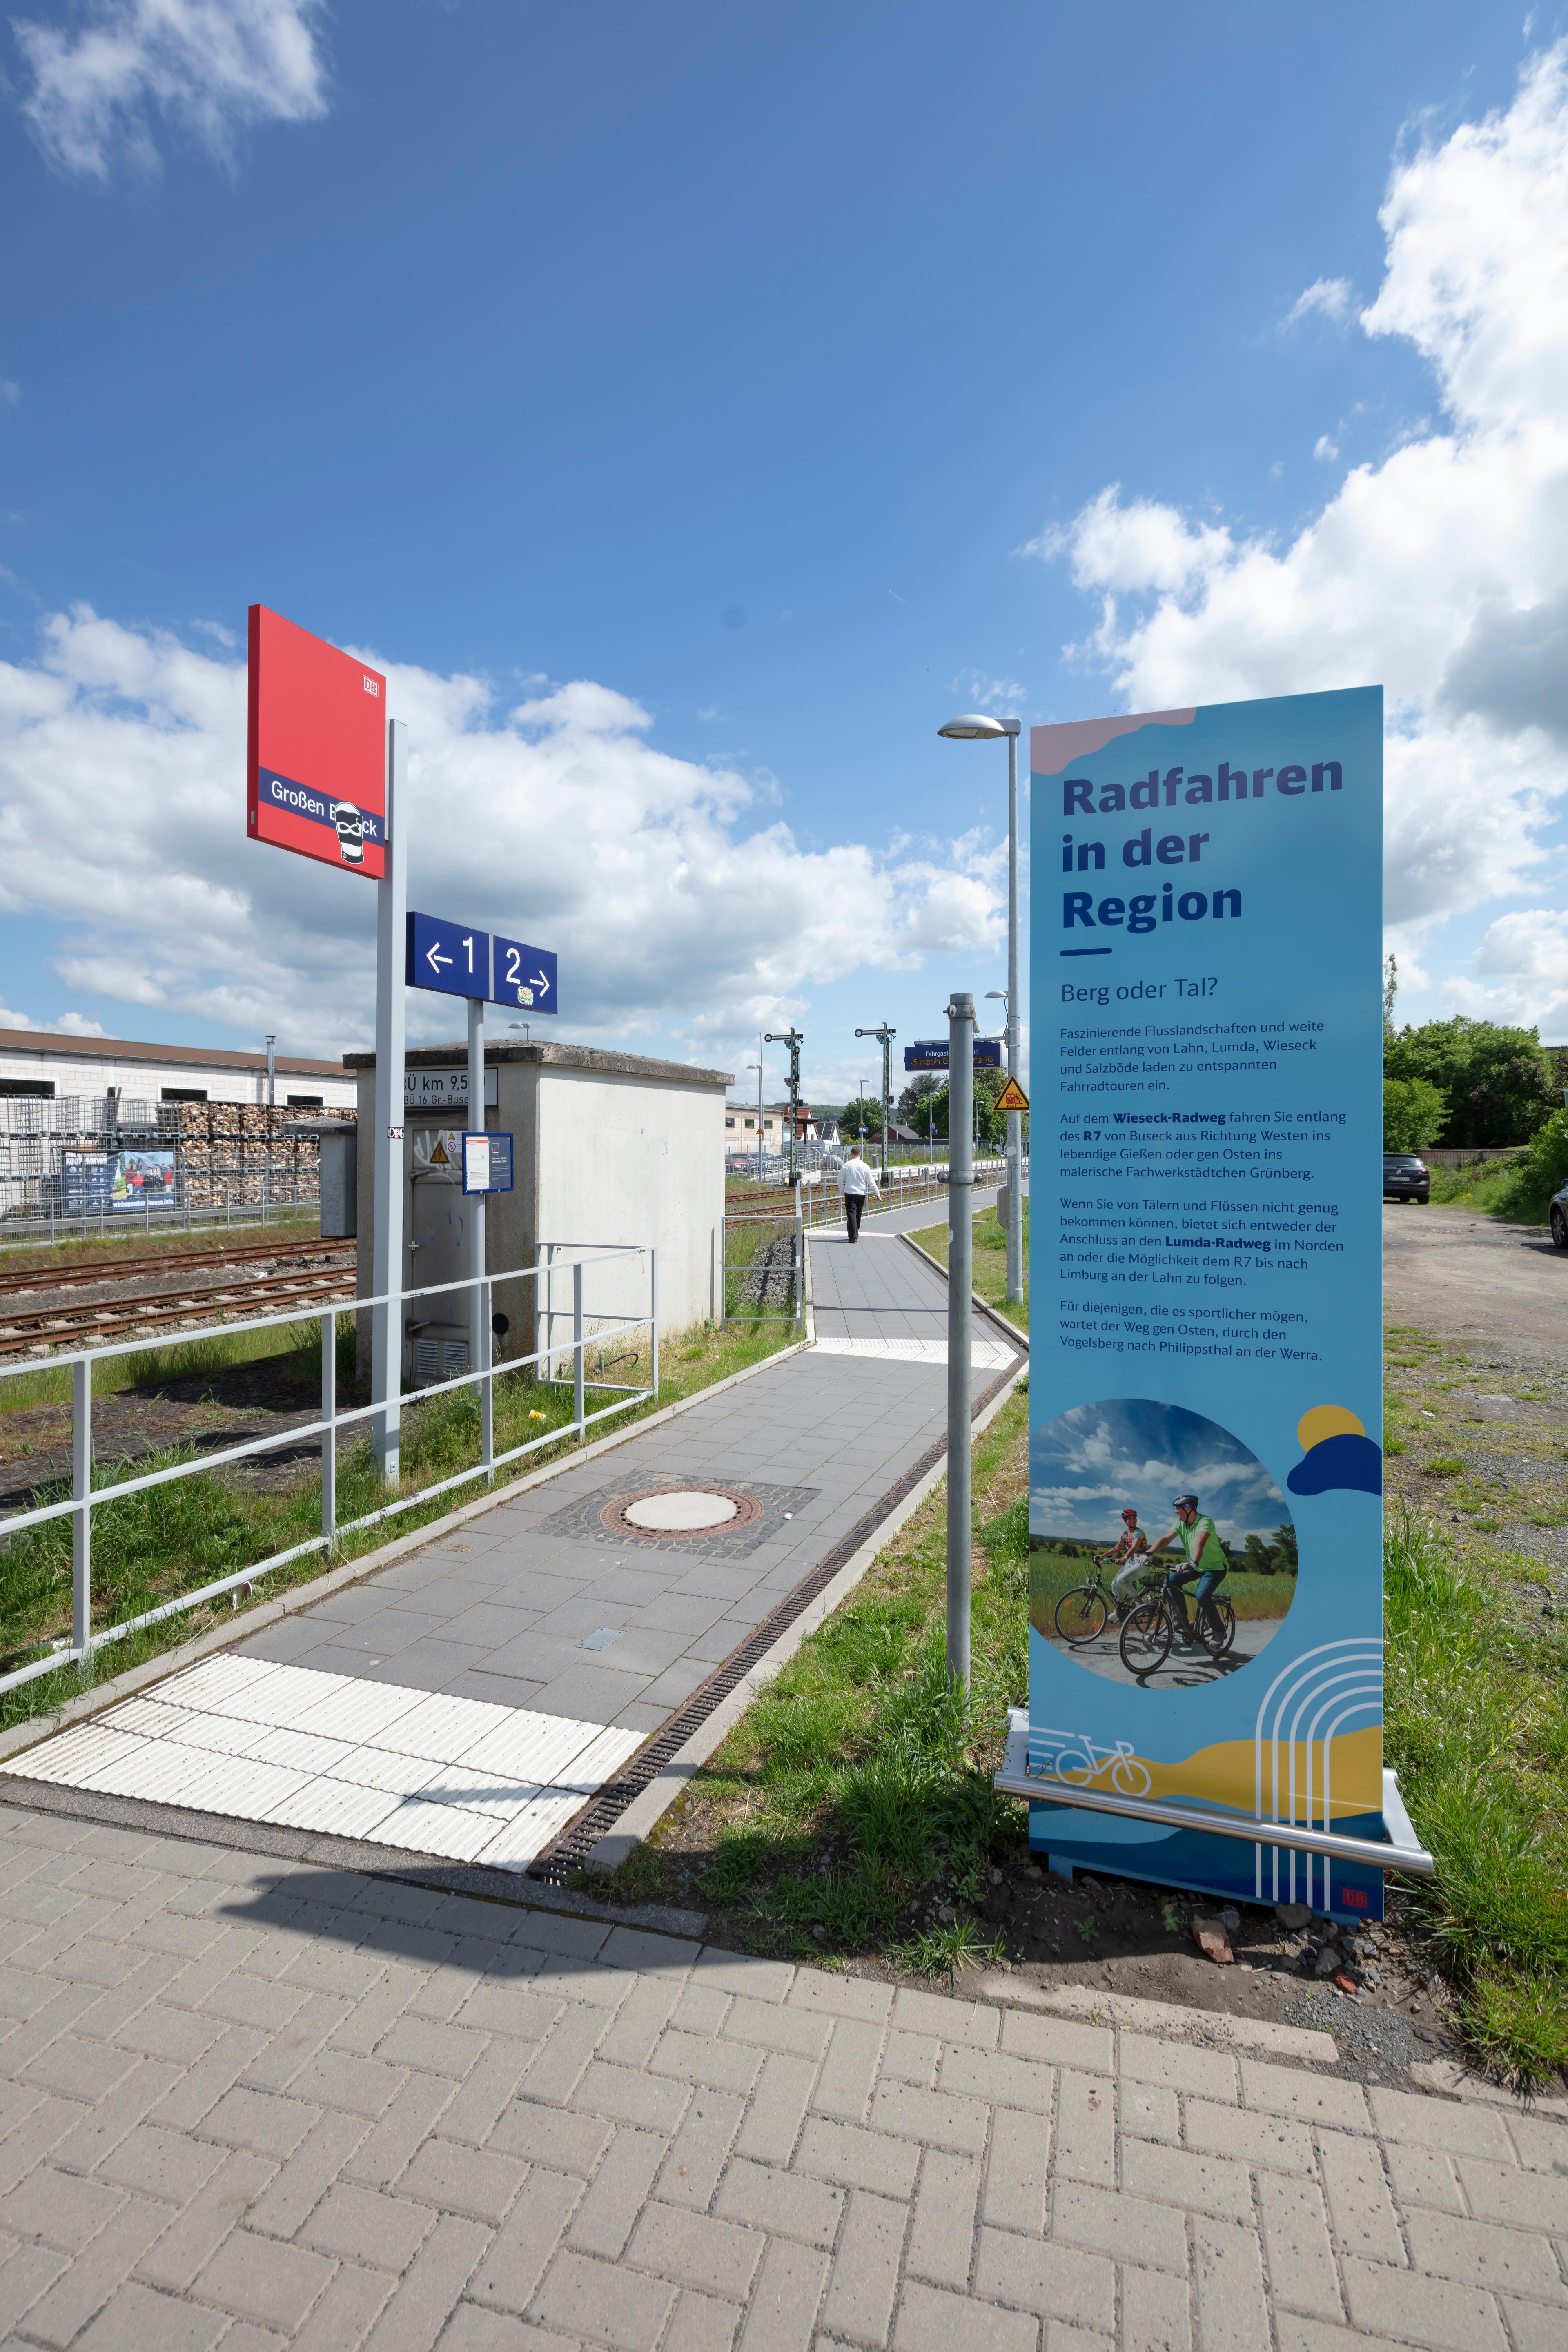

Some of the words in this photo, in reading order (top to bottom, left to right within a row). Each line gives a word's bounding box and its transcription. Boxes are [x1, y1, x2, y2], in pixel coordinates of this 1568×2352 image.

[365, 679, 376, 693] DB
[1063, 761, 1343, 816] Radfahren
[272, 780, 324, 817] Großen
[1062, 834, 1105, 872] in
[1122, 827, 1209, 868] der
[1063, 882, 1242, 934] Region
[463, 935, 473, 973] 1
[506, 947, 520, 984] 2
[1062, 984, 1110, 1005] Berg
[1116, 980, 1167, 1000] oder
[1174, 977, 1218, 997] Tal?
[1060, 1026, 1141, 1039] Faszinierende
[1145, 1022, 1256, 1036] Flusslandschaften
[1261, 1021, 1285, 1033] und
[1288, 1020, 1324, 1032] weite
[1060, 1045, 1097, 1056] Felder
[1100, 1045, 1145, 1057] entlang
[1147, 1046, 1169, 1054] von
[1174, 1042, 1208, 1054] Lahn,
[1212, 1041, 1259, 1053] Lumda,
[1263, 1039, 1317, 1051] Wieseck
[1060, 1063, 1082, 1074] und
[1085, 1062, 1139, 1074] Salzböde
[1143, 1061, 1175, 1072] laden
[1179, 1063, 1193, 1071] zu
[1197, 1060, 1276, 1073] entspannten
[423, 1076, 443, 1091] km
[1060, 1080, 1144, 1091] Fahrradtouren
[1148, 1080, 1169, 1090] ein.
[419, 1095, 427, 1104] 16
[1060, 1113, 1081, 1124] Auf
[1083, 1113, 1109, 1124] dem
[1112, 1112, 1226, 1125] Wieseck-Radweg
[1229, 1111, 1270, 1123] fahren
[1274, 1111, 1293, 1122] Sie
[1296, 1111, 1346, 1125] entlang
[1060, 1131, 1080, 1141] des
[1083, 1131, 1101, 1141] R7
[1104, 1133, 1126, 1141] von
[1130, 1130, 1173, 1141] Buseck
[1176, 1133, 1197, 1141] aus
[1201, 1130, 1257, 1144] Richtung
[1260, 1130, 1308, 1141] Westen
[1312, 1130, 1331, 1141] ins
[1060, 1148, 1117, 1162] lebendige
[1120, 1148, 1162, 1159] Gießen
[1165, 1148, 1194, 1159] oder
[1196, 1151, 1219, 1162] gen
[1223, 1148, 1260, 1160] Osten
[1265, 1149, 1283, 1160] ins
[1060, 1166, 1123, 1177] malerische
[1127, 1167, 1246, 1178] Fachwerkstädtchen
[1250, 1167, 1314, 1181] Grünberg.
[113, 1198, 174, 1207] wirbauenihrzhause.info
[1060, 1198, 1093, 1209] Wenn
[1096, 1198, 1114, 1209] Sie
[1142, 1199, 1179, 1210] Tälern
[1183, 1200, 1206, 1211] und
[1211, 1200, 1258, 1212] Flüssen
[1262, 1201, 1295, 1212] nicht
[1298, 1205, 1339, 1216] genug
[1060, 1215, 1125, 1227] bekommen
[1129, 1217, 1178, 1230] können,
[1182, 1218, 1218, 1229] bietet
[1221, 1219, 1246, 1230] sich
[1250, 1220, 1312, 1232] entweder
[1315, 1221, 1337, 1232] der
[1060, 1233, 1118, 1245] Anschluss
[1121, 1237, 1136, 1245] an
[1139, 1235, 1162, 1246] den
[1165, 1236, 1271, 1252] Lumda-Radweg
[1274, 1239, 1290, 1250] im
[1295, 1239, 1343, 1252] Norden
[1077, 1252, 1104, 1262] oder
[1107, 1252, 1125, 1263] die
[1129, 1253, 1199, 1267] Möglichkeit
[1202, 1255, 1229, 1267] dem
[1234, 1256, 1252, 1267] R7
[1256, 1256, 1273, 1268] bis
[1278, 1258, 1308, 1269] nach
[1060, 1268, 1109, 1283] Limburg
[1111, 1273, 1125, 1281] an
[1129, 1271, 1149, 1282] der
[1152, 1272, 1182, 1283] Lahn
[1186, 1276, 1200, 1284] zu
[1203, 1273, 1246, 1287] folgen.
[1060, 1300, 1080, 1312] Für
[1082, 1301, 1147, 1316] diejenigen,
[1150, 1305, 1169, 1316] die
[1172, 1308, 1185, 1316] es
[1189, 1307, 1257, 1320] sportlicher
[1261, 1310, 1308, 1324] mögen,
[1060, 1321, 1098, 1330] wartet
[1101, 1320, 1120, 1331] der
[1123, 1321, 1150, 1335] Weg
[1152, 1325, 1174, 1336] gen
[1178, 1324, 1218, 1338] Osten,
[1223, 1326, 1258, 1339] durch
[1262, 1328, 1286, 1340] den
[1060, 1336, 1124, 1352] Vogelsberg
[1127, 1341, 1156, 1351] nach
[1160, 1341, 1232, 1356] Philippsthal
[1236, 1348, 1251, 1357] an
[1255, 1346, 1276, 1358] der
[1279, 1348, 1322, 1361] Werra.
[1346, 1891, 1365, 1904] DB
